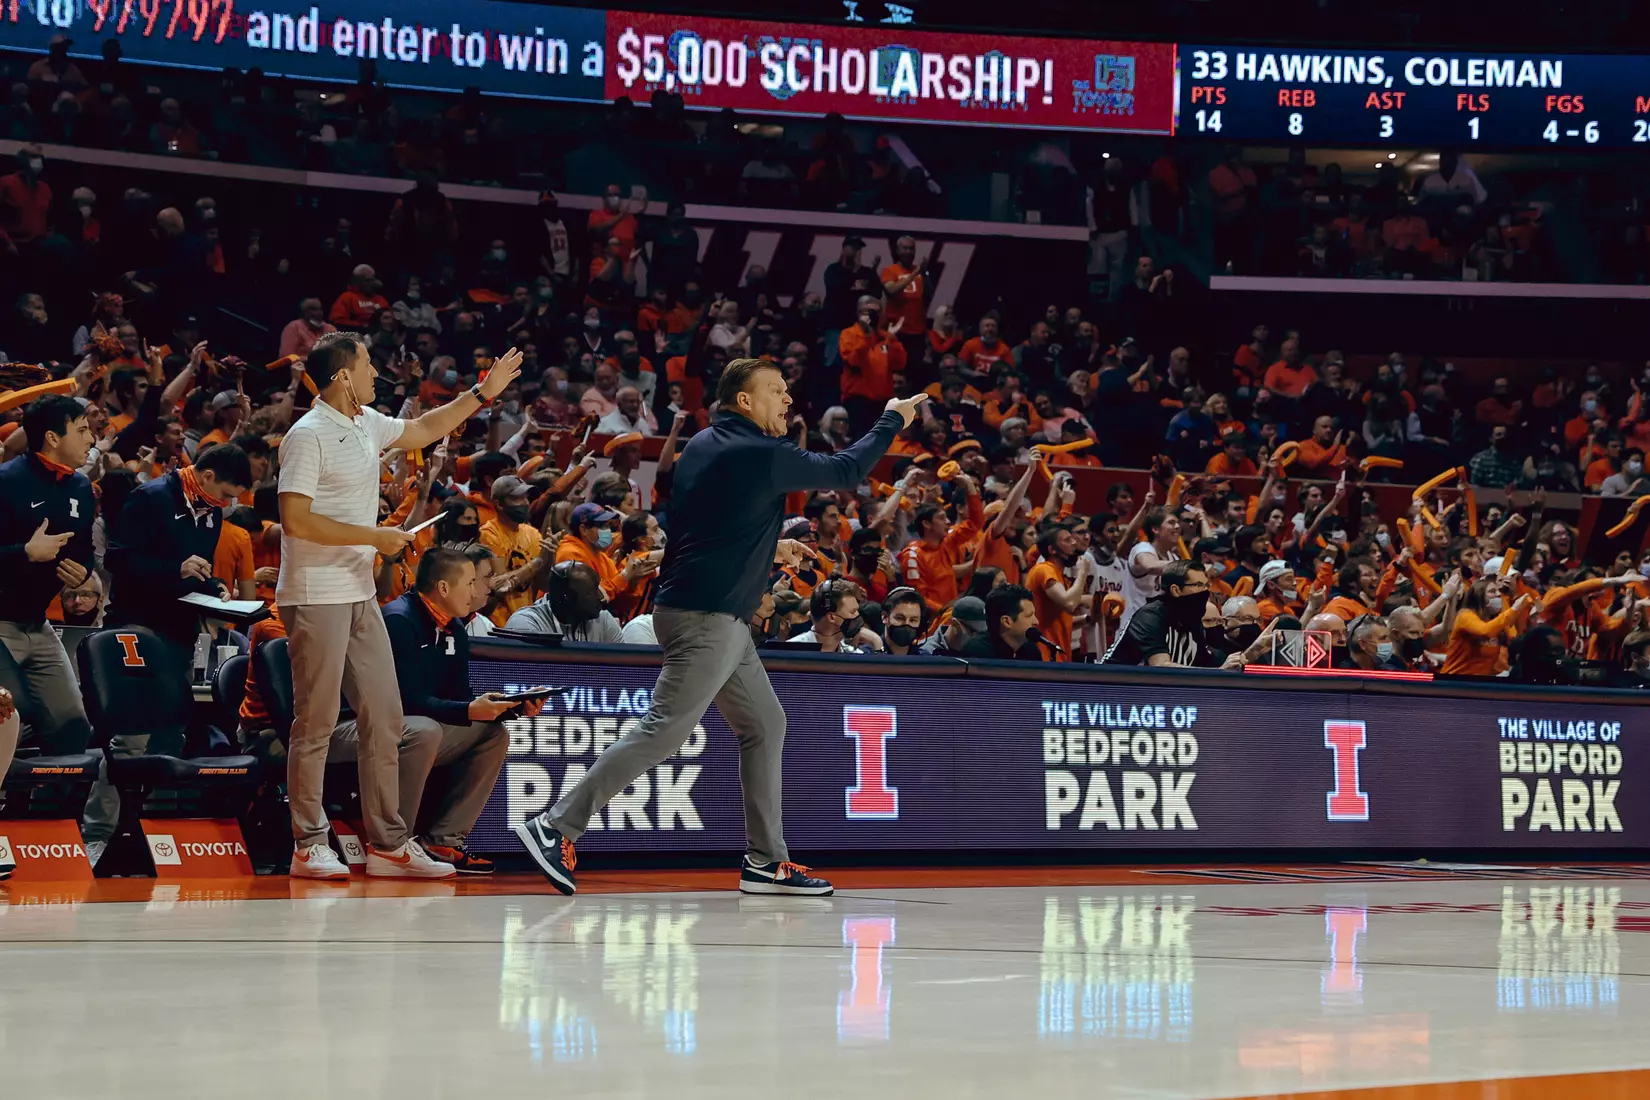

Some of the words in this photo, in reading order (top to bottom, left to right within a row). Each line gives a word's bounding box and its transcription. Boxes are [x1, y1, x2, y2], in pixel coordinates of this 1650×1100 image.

[246, 7, 319, 53] and
[332, 16, 438, 63] enter
[450, 23, 487, 68] to
[499, 26, 568, 75] win
[581, 40, 604, 77] a
[616, 27, 747, 92] $5,000
[760, 43, 1054, 104] SCHOLARSHIP!
[1192, 51, 1228, 80] 33
[1236, 53, 1394, 88] HAWKINS,
[1405, 57, 1563, 88] COLEMAN
[1191, 86, 1227, 105] PTS
[1278, 89, 1316, 107] REB
[1365, 92, 1406, 110] AST
[1456, 94, 1490, 112] FLS
[1545, 95, 1585, 113] FGS
[1195, 110, 1222, 133] 14
[1288, 112, 1304, 136] 8
[1378, 115, 1394, 138] 3
[1468, 117, 1480, 140] 1
[1632, 119, 1650, 143] 2
[562, 686, 655, 713] VILLAG
[1041, 700, 1080, 725] THE
[1085, 703, 1166, 728] VILLAGE
[1171, 706, 1197, 728] OF
[504, 715, 707, 757] BEDFD
[1043, 728, 1199, 767] BEDFORD
[1497, 717, 1528, 739] THE
[1532, 719, 1596, 741] VILLAGE
[1599, 721, 1621, 742] OF
[843, 704, 899, 820] I
[1323, 719, 1369, 821] I
[1499, 741, 1623, 775] BEDFORD
[1045, 770, 1199, 830] PARK
[1501, 777, 1624, 832] PARK
[16, 844, 87, 859] TOYOTA
[181, 842, 247, 857] TOYOTA
